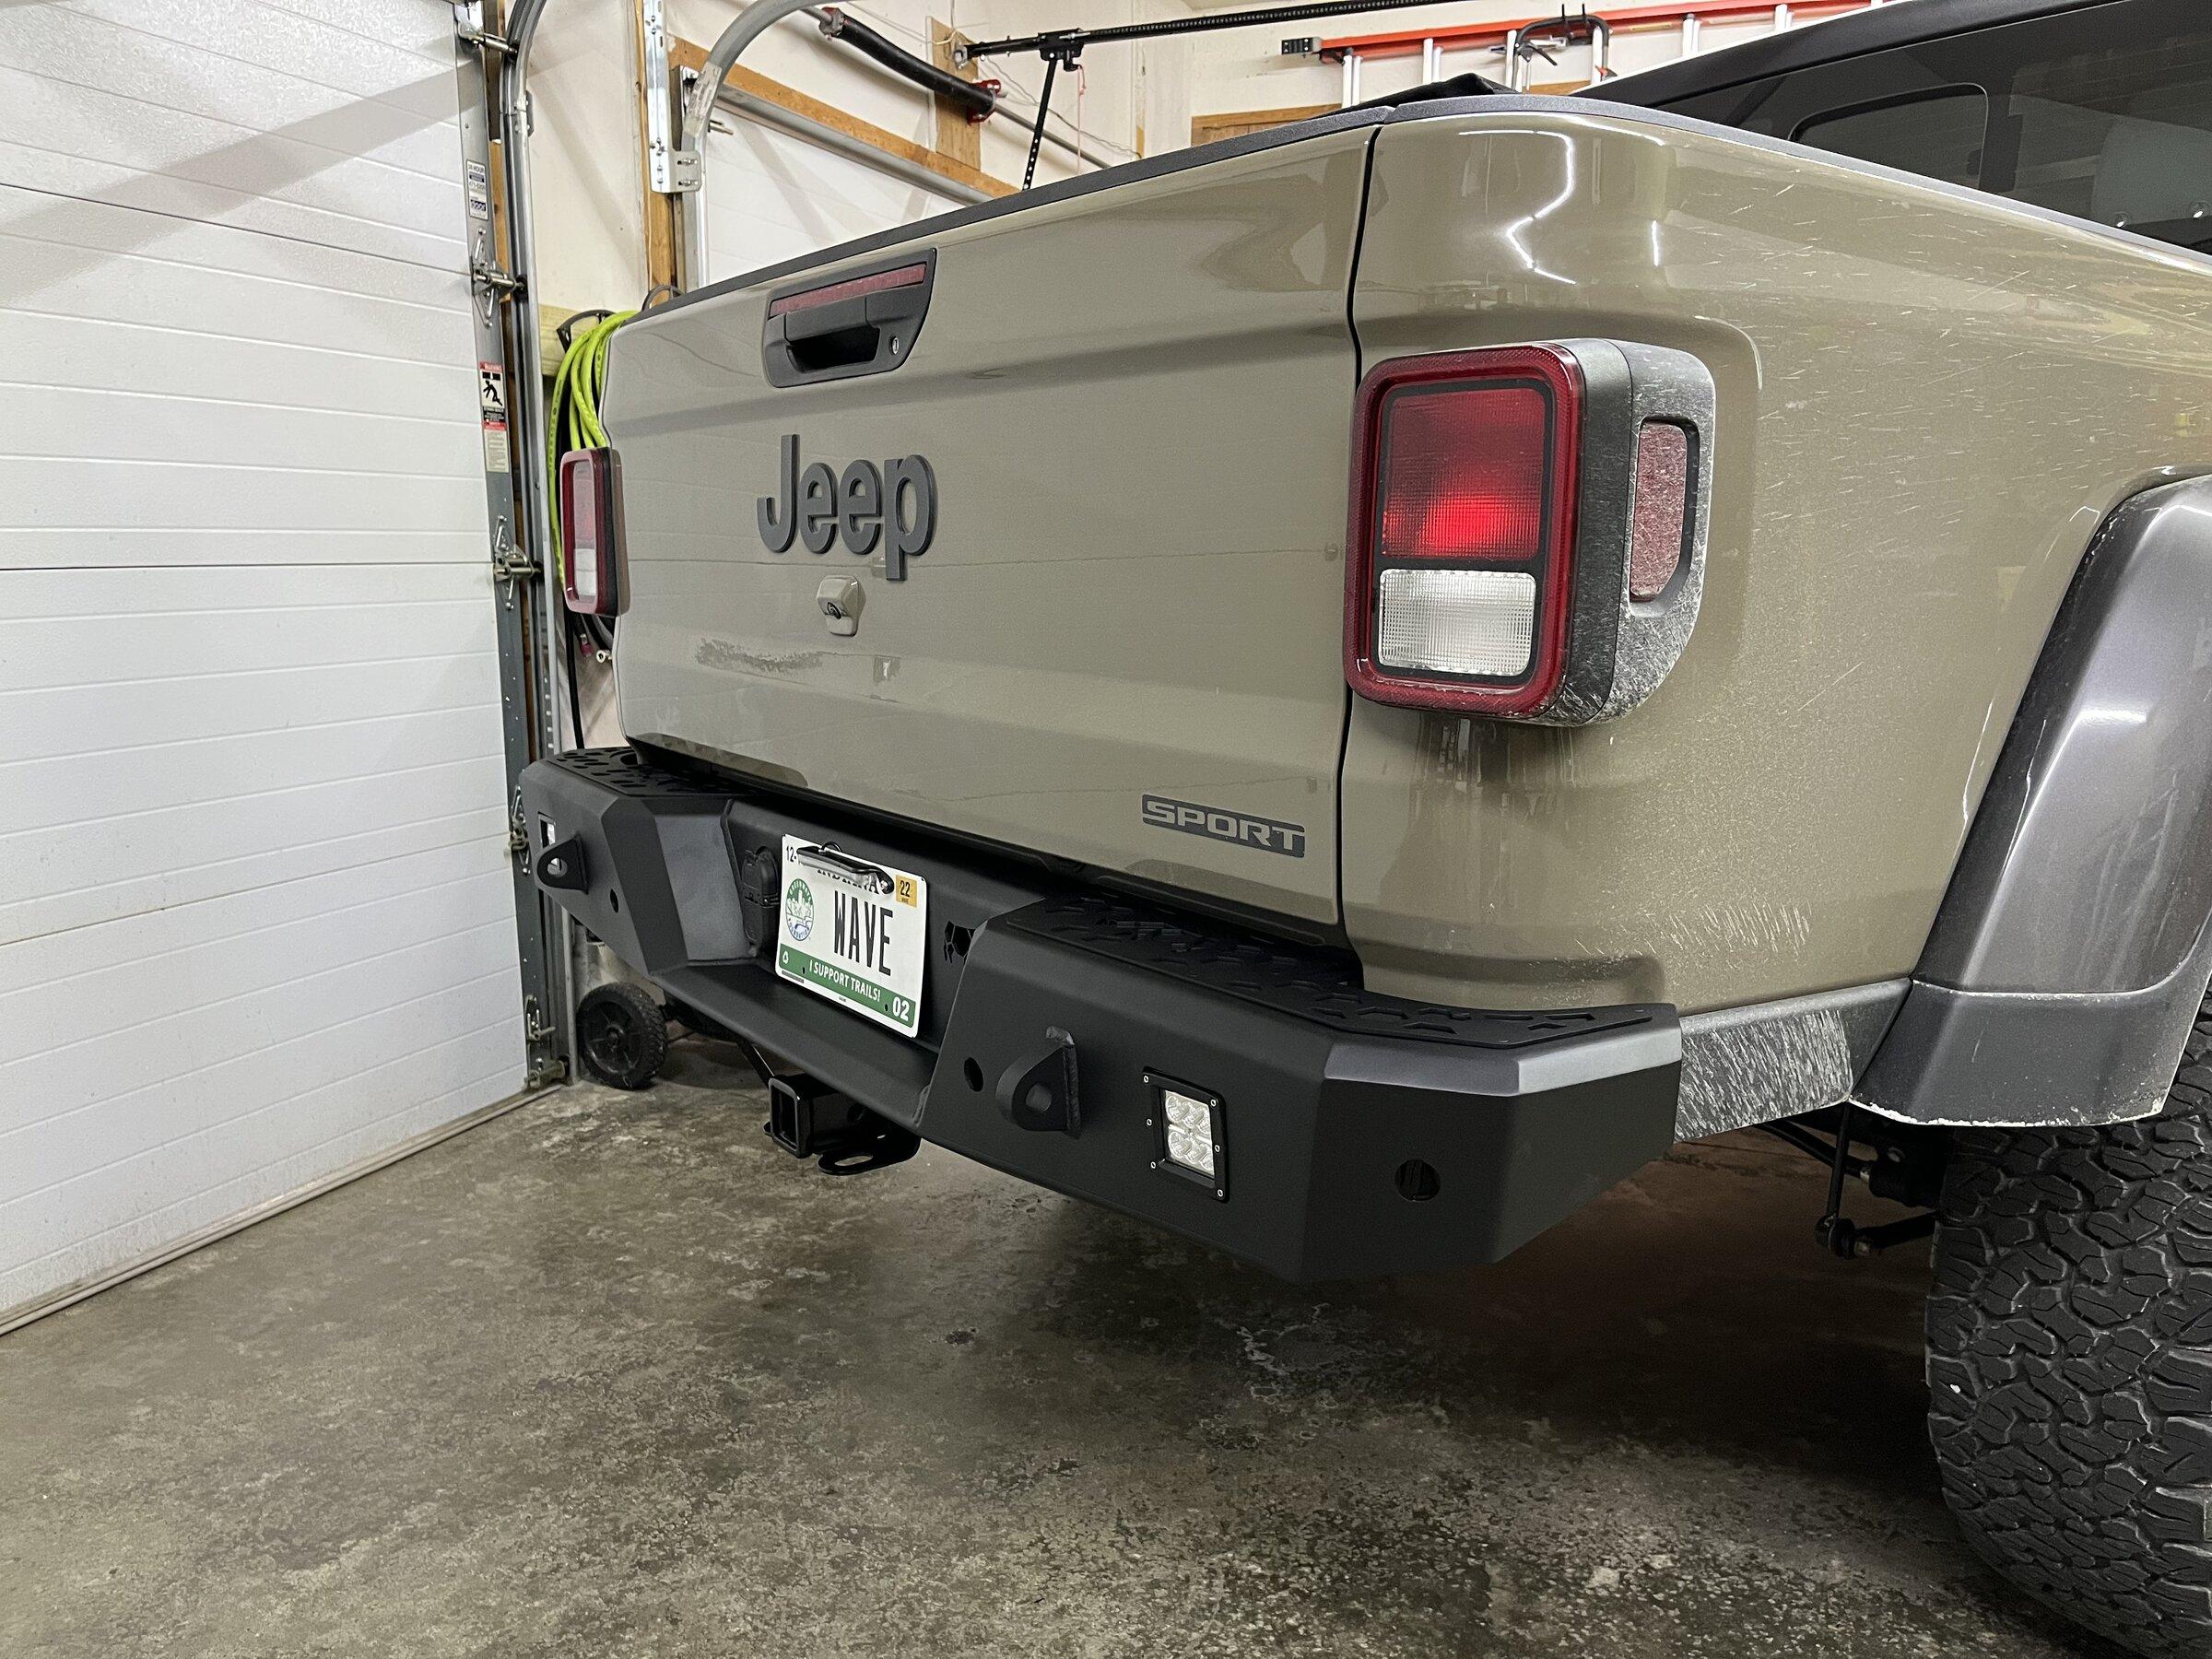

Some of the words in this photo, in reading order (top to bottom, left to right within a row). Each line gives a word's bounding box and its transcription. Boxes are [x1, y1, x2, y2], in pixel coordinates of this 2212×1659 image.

[757, 434, 937, 581] Jeep
[1143, 799, 1305, 852] SPORT
[900, 879, 911, 898] 22
[834, 890, 893, 977] WAVE
[809, 959, 813, 972] I
[814, 961, 849, 988] SUPPORT
[850, 977, 881, 1003] TRAILS!
[892, 996, 911, 1022] 02
